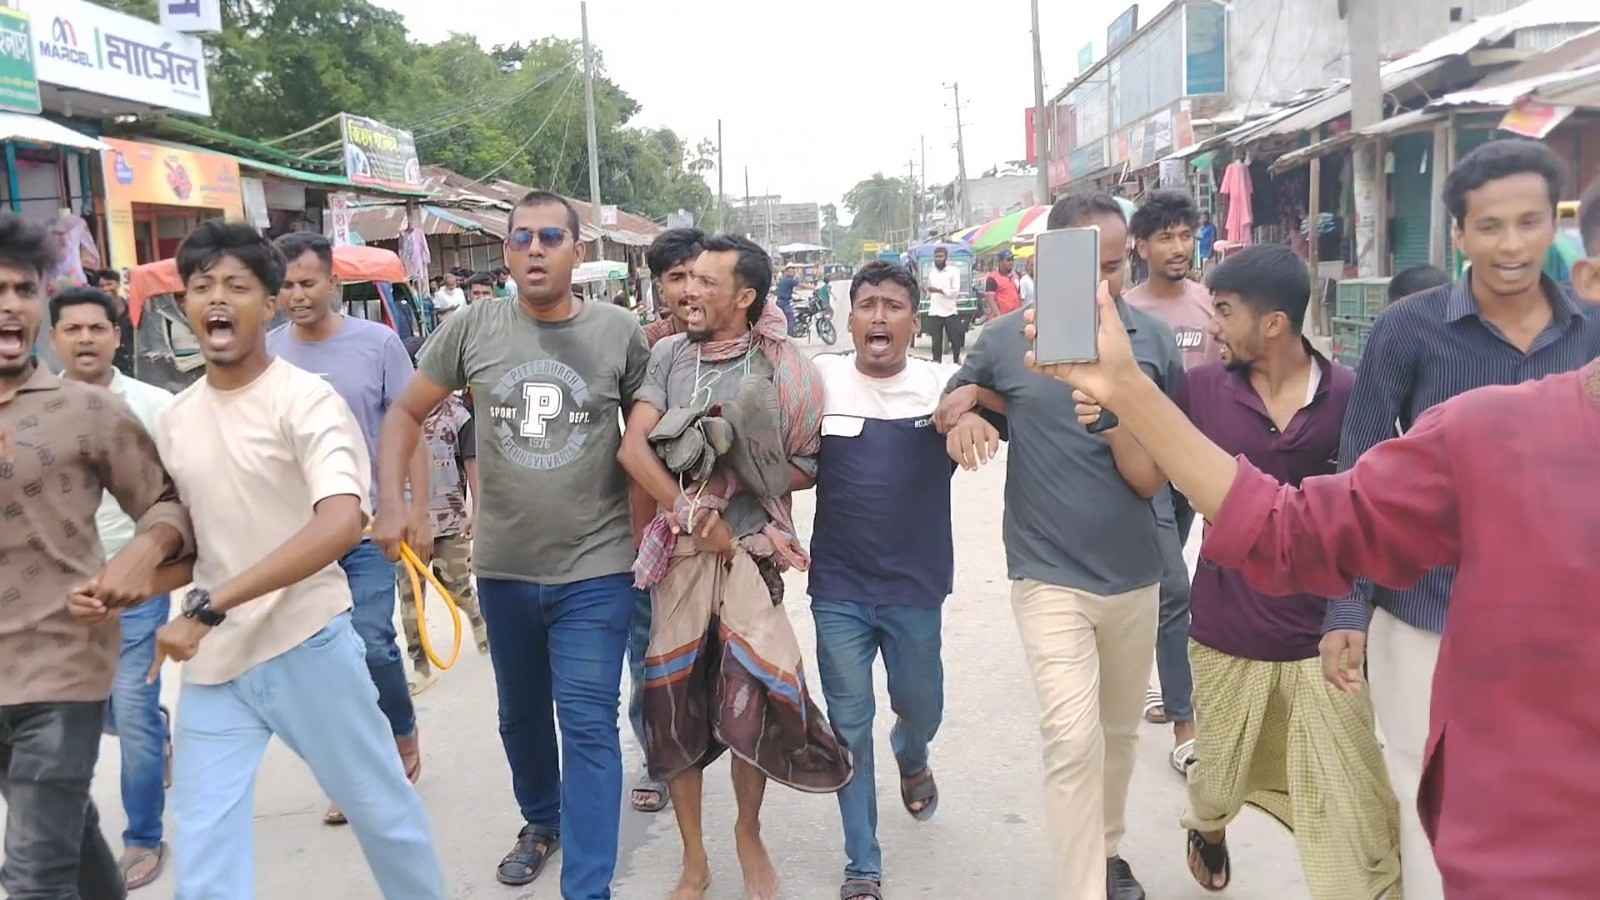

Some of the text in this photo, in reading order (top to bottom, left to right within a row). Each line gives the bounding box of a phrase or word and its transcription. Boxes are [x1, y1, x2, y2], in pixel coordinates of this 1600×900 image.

[39, 40, 93, 68] MARCEL
[104, 33, 200, 90] মার্সেল
[489, 406, 517, 419] SPORT
[520, 382, 563, 438] P
